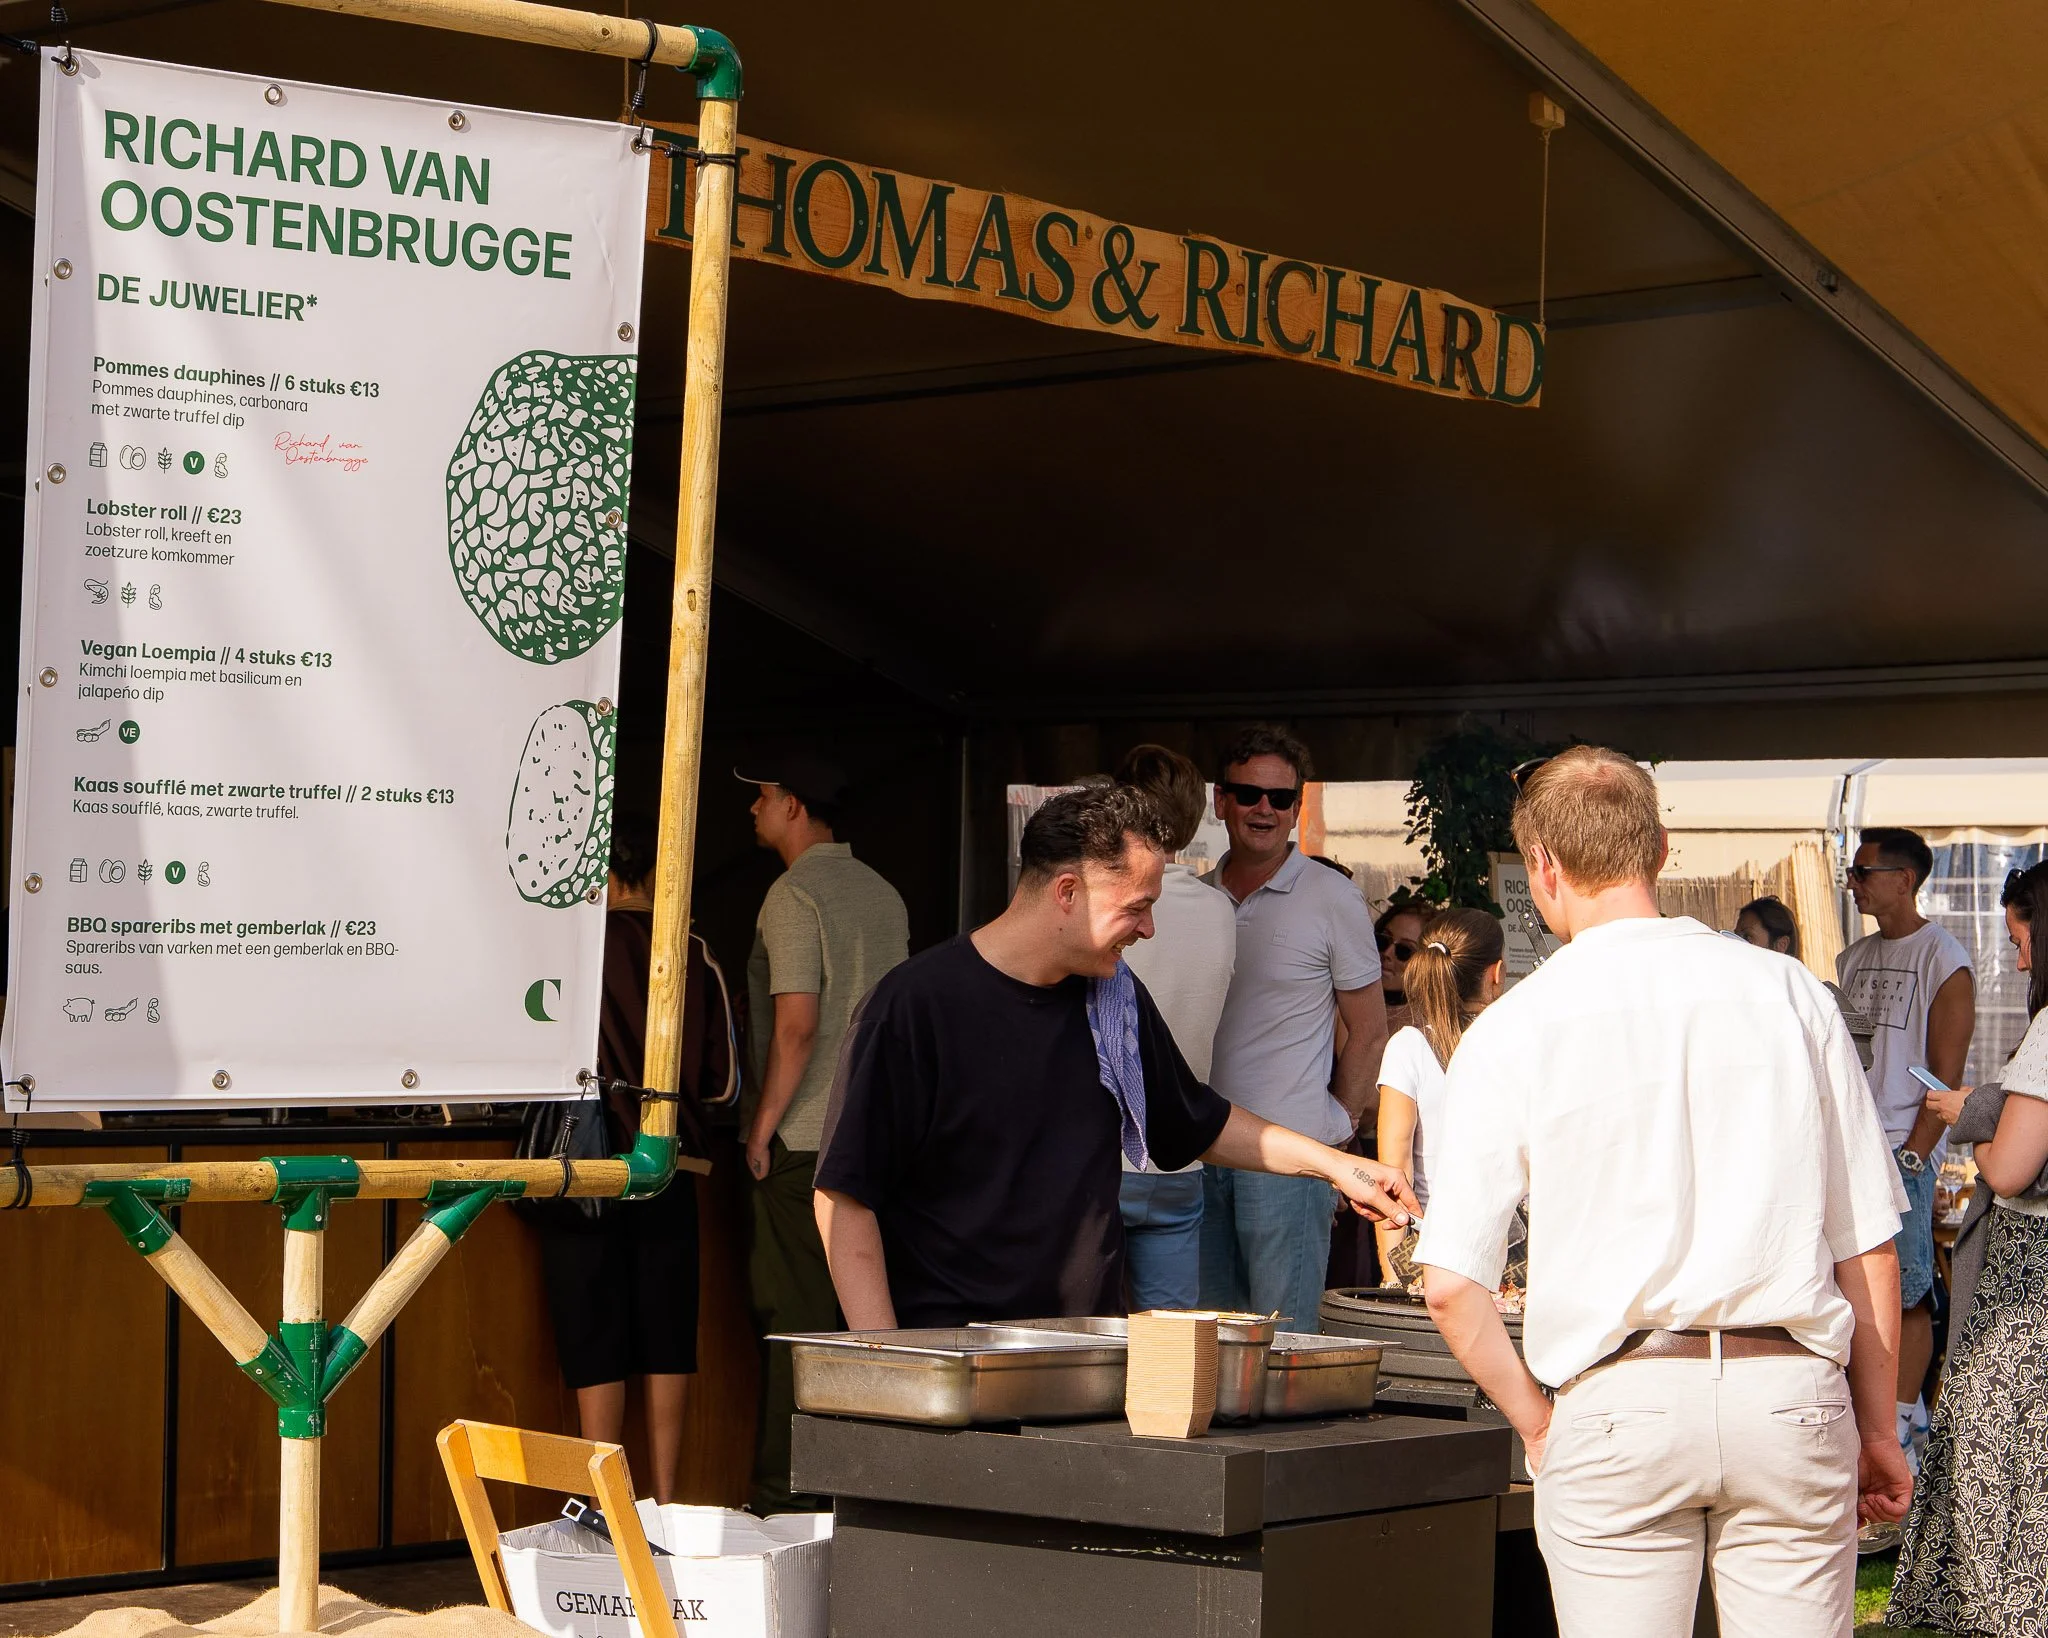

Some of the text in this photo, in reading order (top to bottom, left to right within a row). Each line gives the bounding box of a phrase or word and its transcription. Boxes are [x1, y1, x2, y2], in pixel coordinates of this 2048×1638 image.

[104, 109, 490, 206] RICHARD VAN
[101, 179, 573, 281] OOSTENBRUGGE
[652, 129, 1545, 405] THOMAS & RICHARD
[98, 273, 141, 304] DE
[93, 356, 169, 379] Pommes
[174, 365, 265, 388] dauphines
[284, 375, 295, 390] 6
[299, 376, 346, 395] stuks
[350, 381, 380, 398] €13
[92, 380, 308, 413] Pommes dauphines, carbonara
[91, 403, 245, 429] met zwarte truffel dip
[274, 431, 330, 452] Richard
[285, 446, 369, 472] Oostenbrugge
[87, 498, 156, 519] Lobster
[160, 505, 187, 521] roll
[207, 508, 242, 525] €23
[86, 522, 232, 544] Lobster roll, kreeft en
[85, 545, 235, 565] zoetzure komkommer
[81, 640, 137, 660] Vegan
[142, 643, 216, 663] Loempia
[235, 648, 245, 663] 4
[249, 649, 296, 666] stuks
[300, 652, 332, 668] €13
[79, 662, 302, 686] Kimchi loempia met basilicum en
[143, 687, 164, 703] dip
[122, 727, 137, 738] VE
[74, 776, 119, 793] Kaas
[123, 779, 186, 795] soufflé
[190, 783, 223, 796] met
[227, 784, 285, 798] zwarte
[289, 784, 341, 800] truffel
[361, 787, 371, 801] 2
[375, 788, 422, 803] stuks
[426, 788, 455, 804] €13
[73, 799, 299, 819] Kaas soufflé, kaas, zwarte truffel.
[67, 917, 107, 934] BBQ
[111, 919, 196, 938] spareribs
[199, 920, 233, 935] met
[236, 920, 326, 940] gemberlak
[345, 920, 376, 936] €23
[66, 939, 399, 958] Spareribs van varken met een gemberlak en BBQ-
[65, 962, 102, 976] saus.
[1352, 1168, 1376, 1187] 1996
